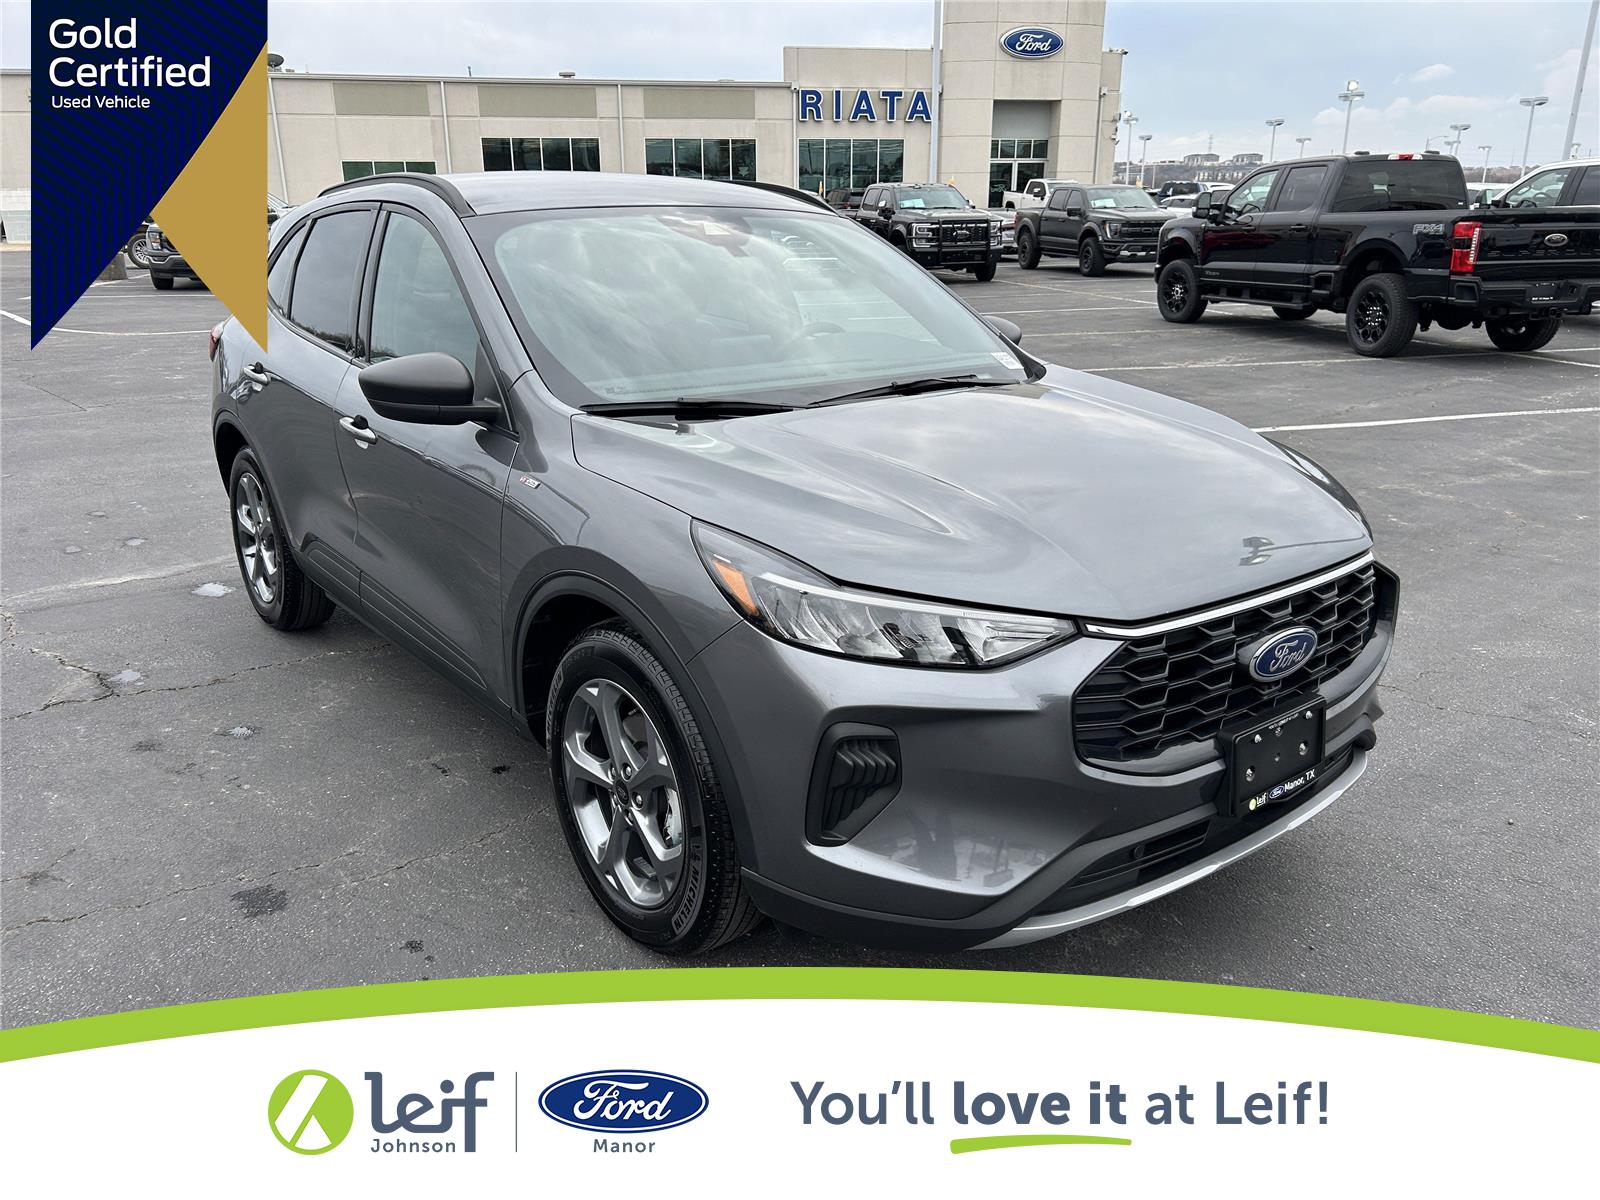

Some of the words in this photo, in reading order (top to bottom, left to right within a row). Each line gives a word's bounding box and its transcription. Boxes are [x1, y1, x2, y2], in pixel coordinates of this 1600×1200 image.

[1015, 33, 1053, 52] Ford
[798, 87, 932, 123] RIATA
[1412, 223, 1445, 235] FX4
[1269, 639, 1307, 672] Ford
[1284, 776, 1305, 792] Manor,
[1305, 768, 1316, 781] TX
[673, 864, 700, 931] MICHELIN
